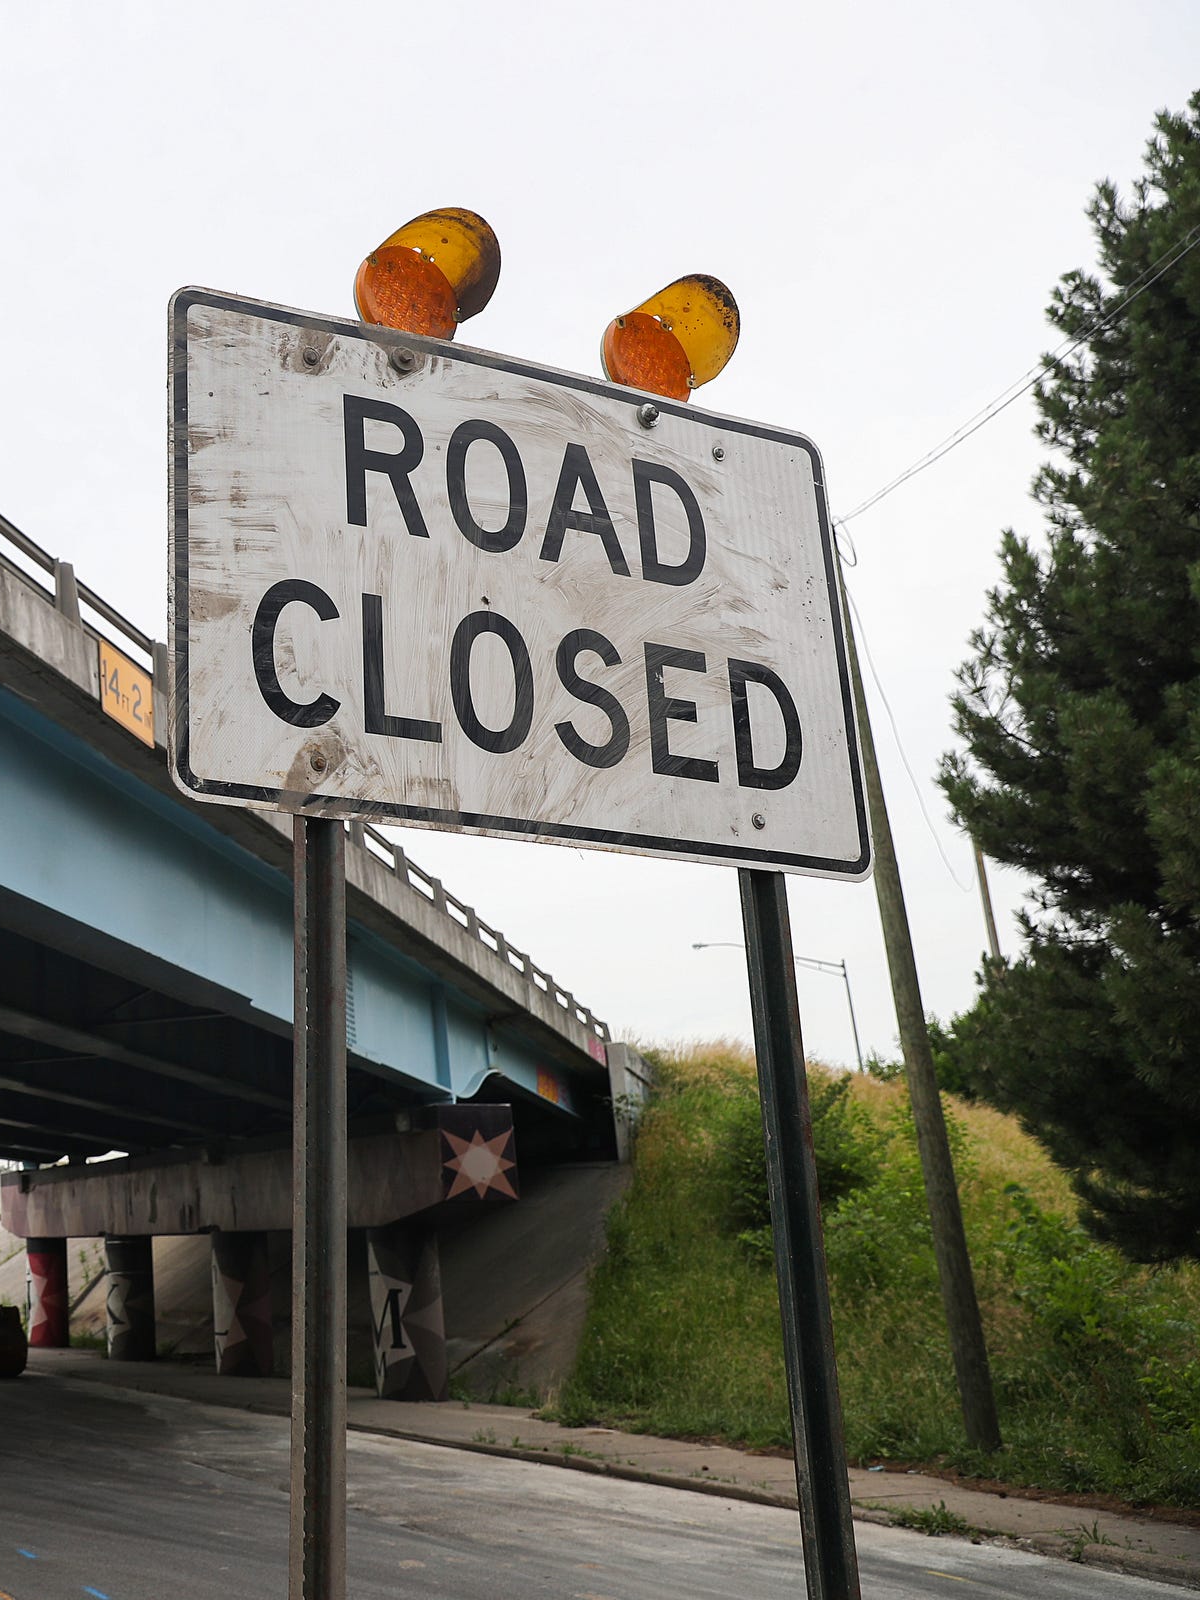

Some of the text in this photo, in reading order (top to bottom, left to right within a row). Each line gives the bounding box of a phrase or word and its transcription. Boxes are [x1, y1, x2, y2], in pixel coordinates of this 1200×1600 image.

[342, 393, 707, 586] ROAD
[102, 659, 120, 704] 14
[131, 682, 143, 722] 2
[251, 578, 801, 790] CLOSED
